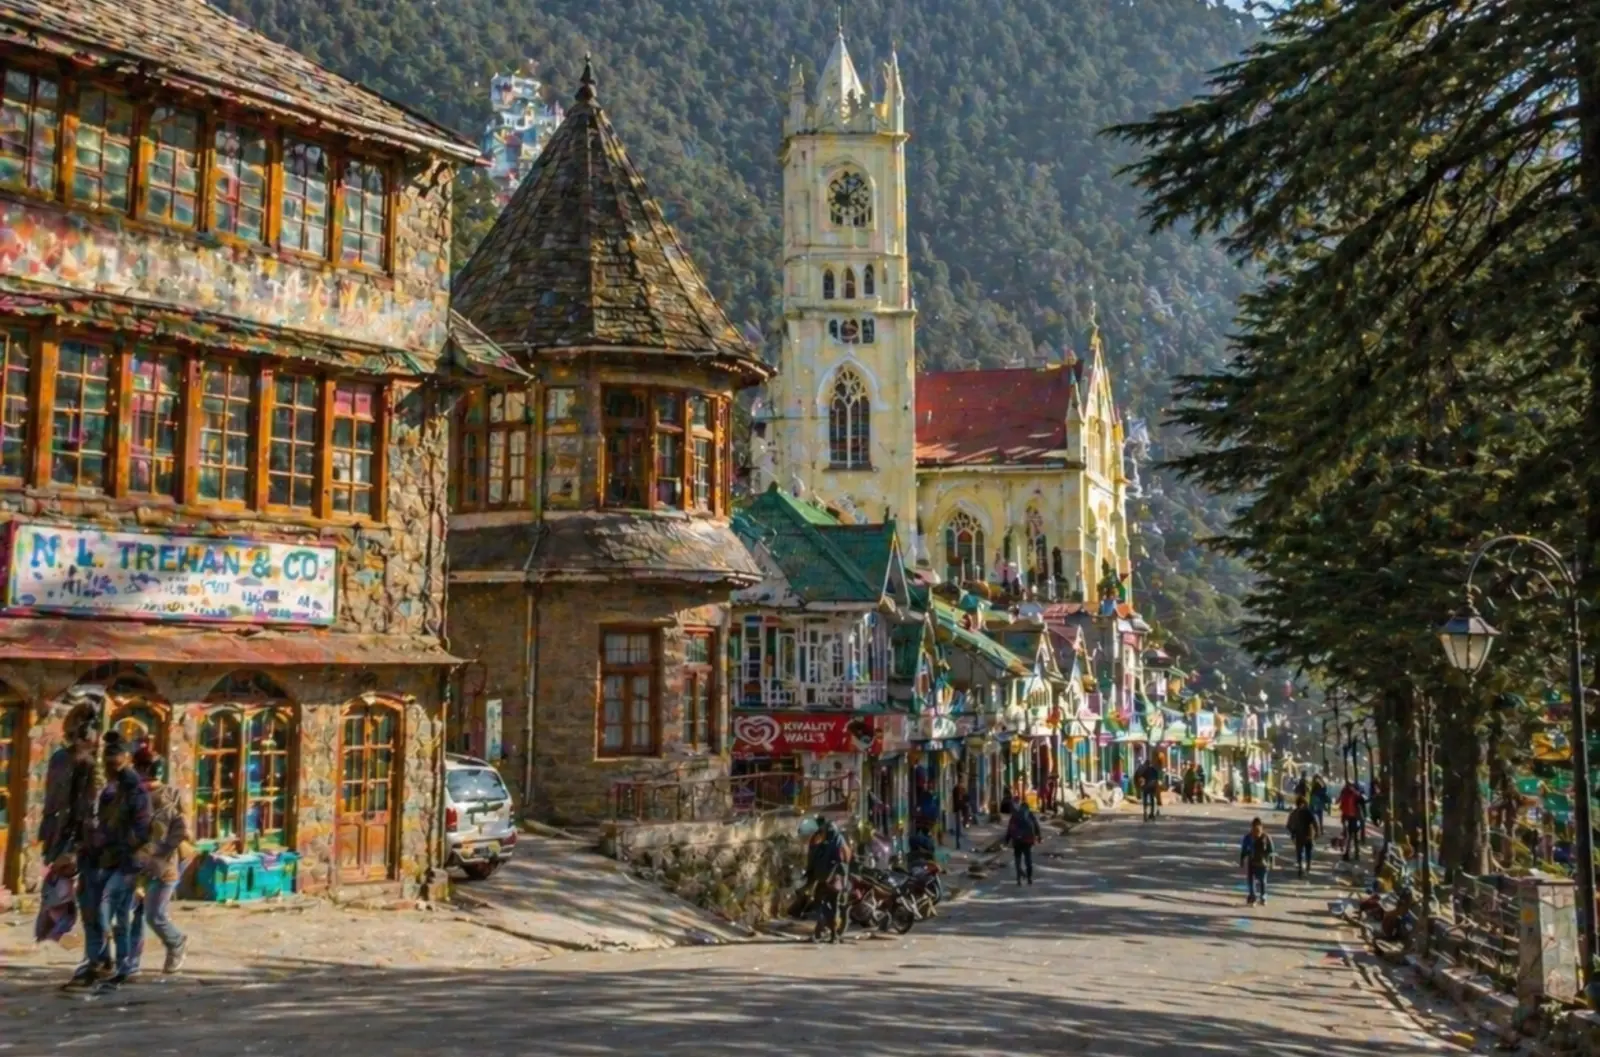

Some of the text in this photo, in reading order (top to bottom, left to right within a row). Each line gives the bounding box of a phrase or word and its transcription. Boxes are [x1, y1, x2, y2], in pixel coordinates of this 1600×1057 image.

[117, 541, 241, 575] TREHAN
[251, 547, 273, 579] &
[783, 721, 836, 731] KWALITY
[783, 733, 826, 743] WALL'S
